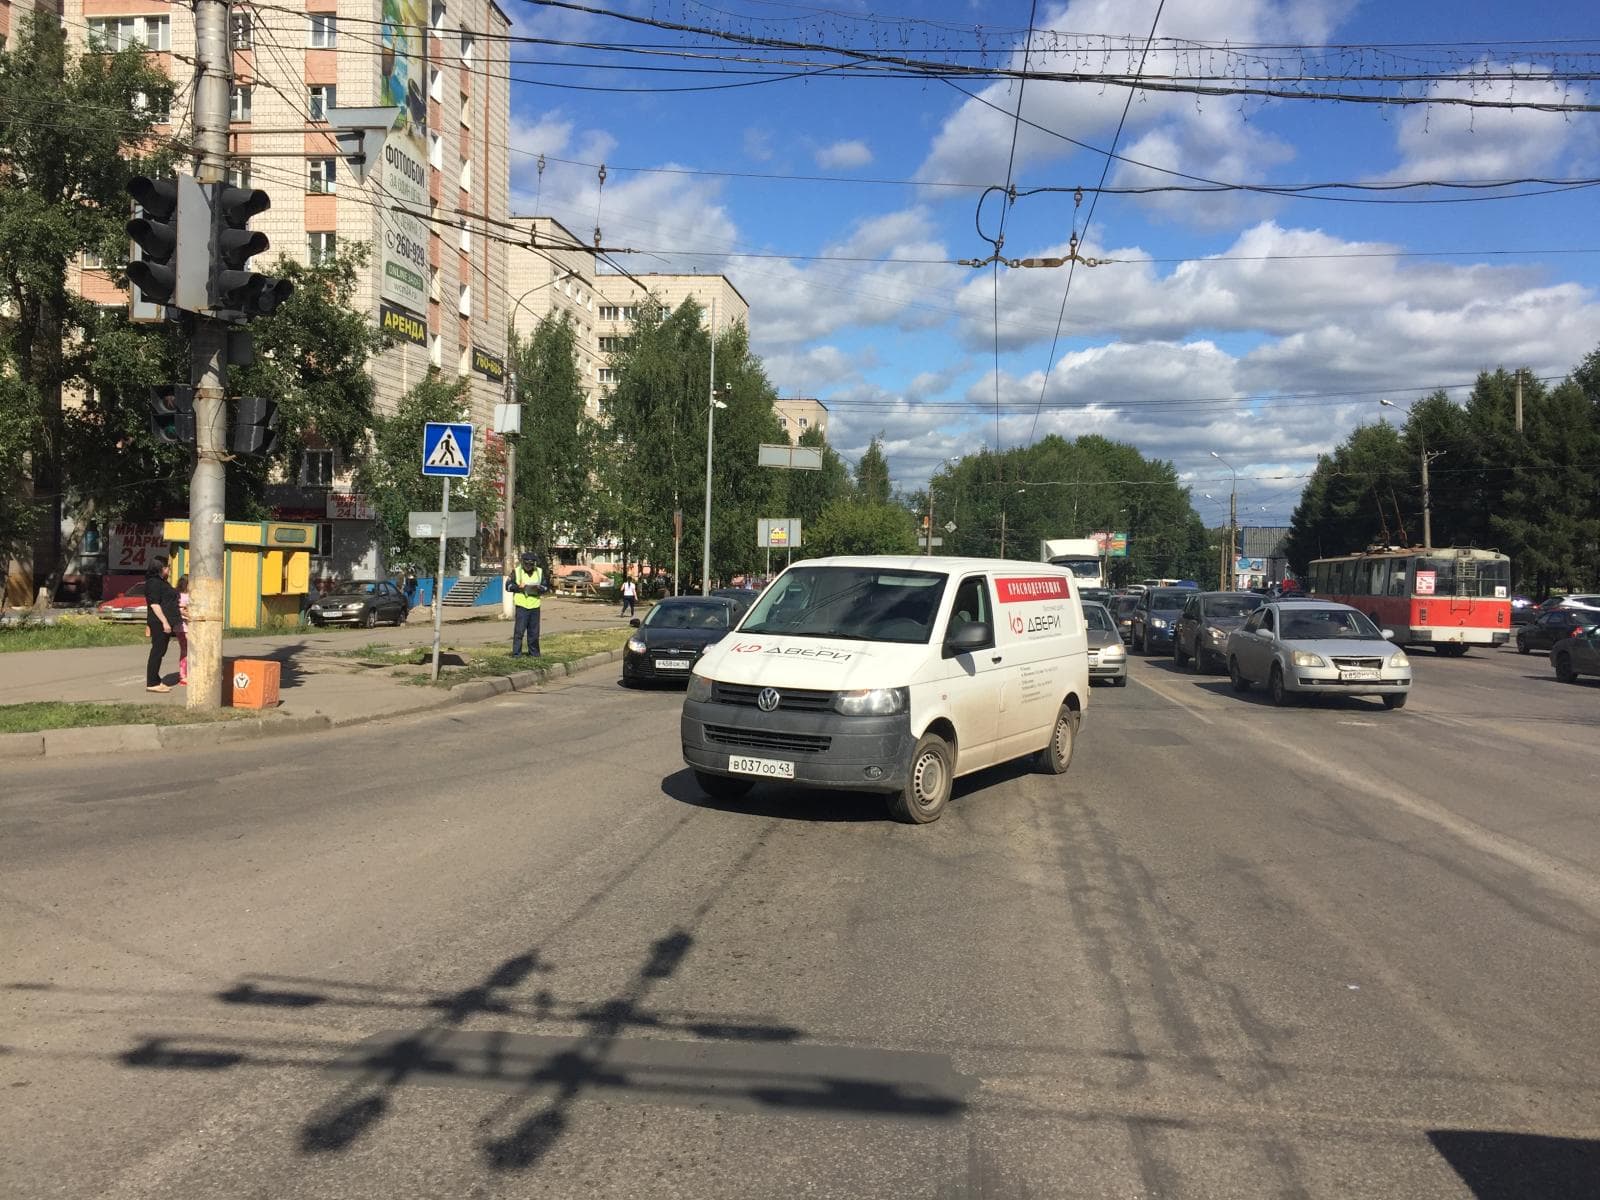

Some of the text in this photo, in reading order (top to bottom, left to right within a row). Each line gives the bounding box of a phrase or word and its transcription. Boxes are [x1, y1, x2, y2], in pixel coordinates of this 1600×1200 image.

[386, 144, 424, 188] ФОТООБОИ
[384, 311, 425, 340] АРЕНДА
[337, 508, 351, 517] 24
[115, 523, 154, 535] МИНИ
[123, 536, 168, 548] МАРКЕ
[119, 547, 146, 565] 24
[1007, 581, 1062, 596] КРАСНОДЕРЕВЩИК
[1028, 614, 1061, 632] ДВЕРИ
[765, 647, 852, 661] ДВЕРИ
